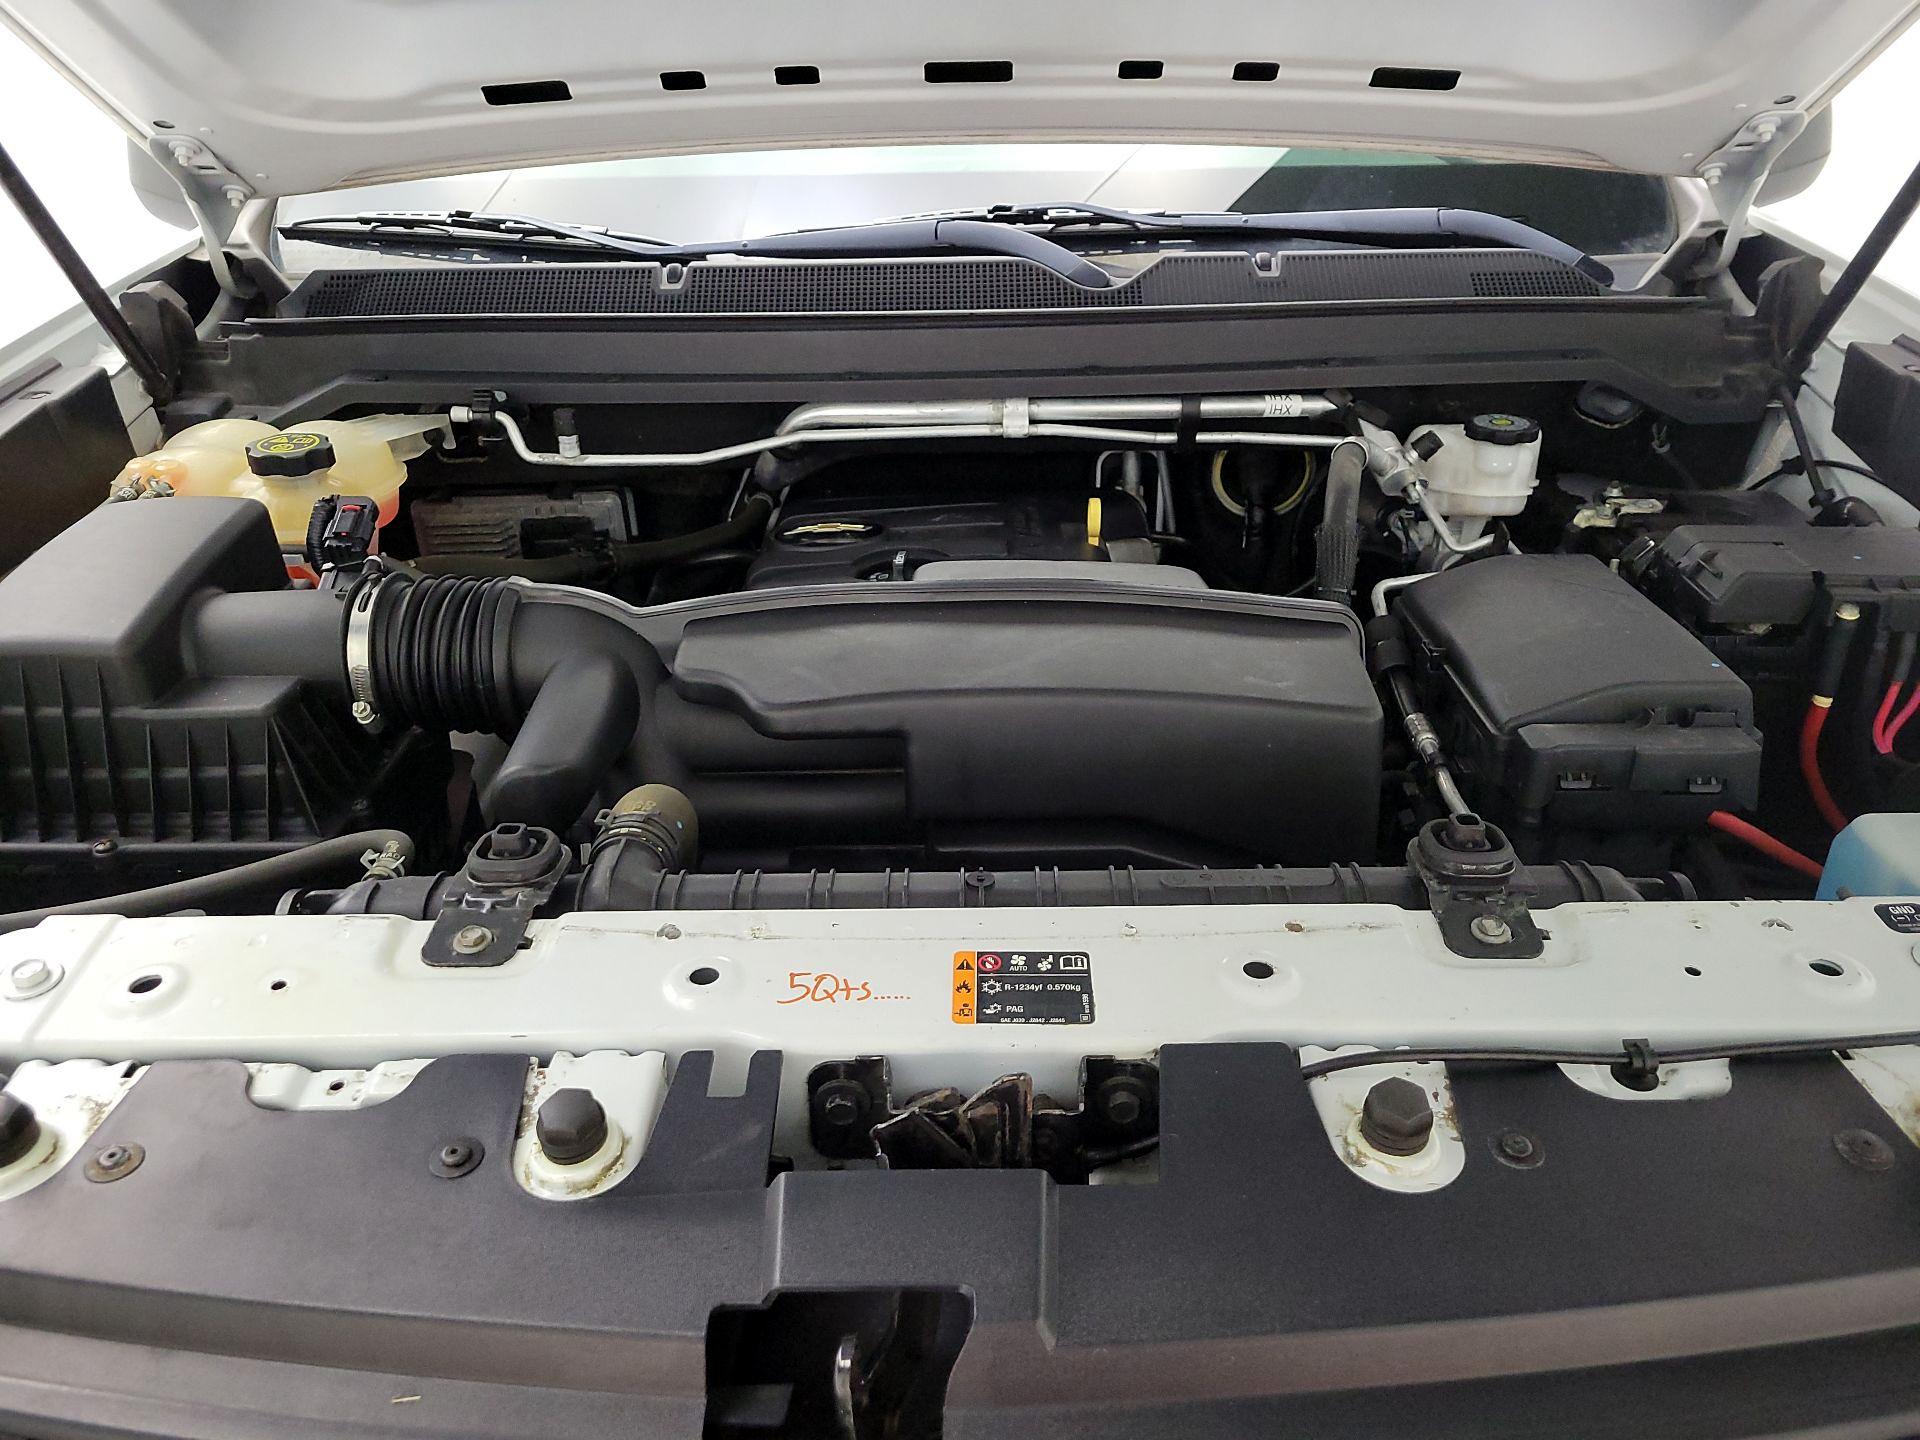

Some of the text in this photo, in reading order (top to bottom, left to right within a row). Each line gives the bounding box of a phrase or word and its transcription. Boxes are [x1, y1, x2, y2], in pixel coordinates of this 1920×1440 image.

[1888, 905, 1916, 914] GND
[1004, 983, 1081, 992] R-1234yf 0.570kg
[1006, 1005, 1024, 1013] PAG
